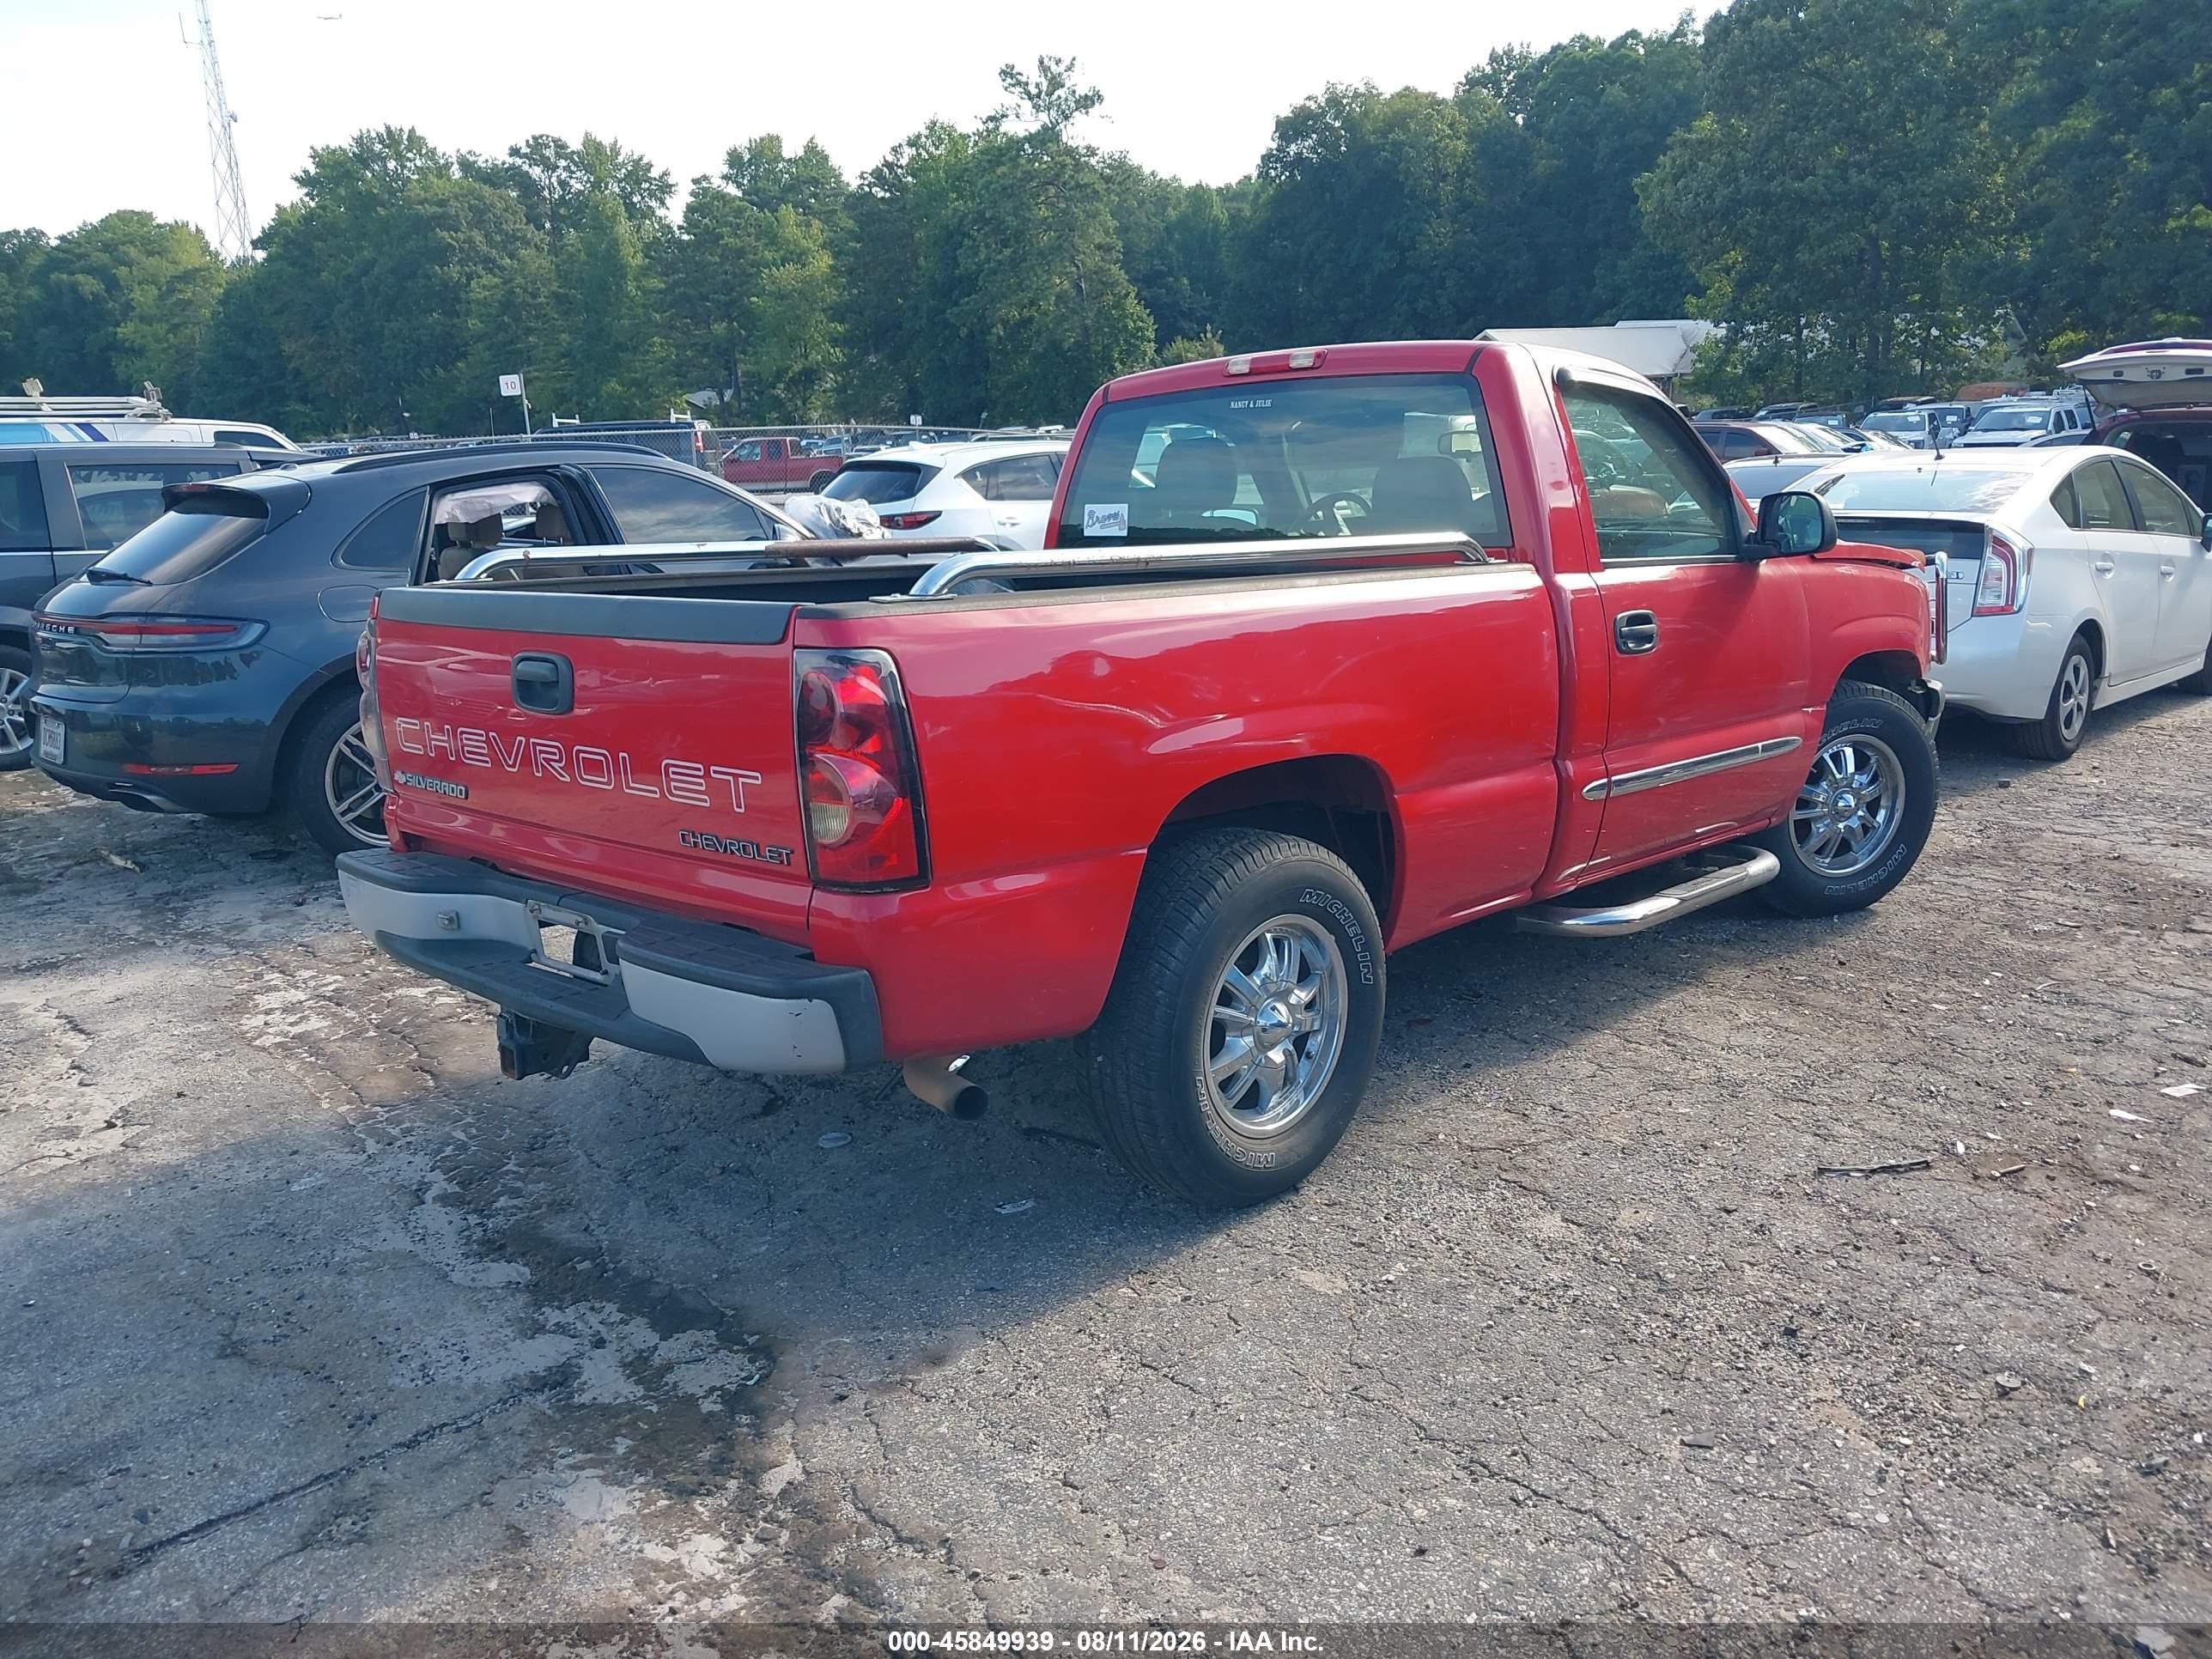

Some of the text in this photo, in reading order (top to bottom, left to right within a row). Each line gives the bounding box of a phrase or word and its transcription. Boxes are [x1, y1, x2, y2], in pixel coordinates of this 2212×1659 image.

[505, 380, 517, 390] 10
[1230, 400, 1249, 409] NANCY
[397, 717, 762, 812] CHEVROLET
[406, 773, 466, 799] SILVERADO
[678, 830, 792, 866] CHEVROLET
[1823, 843, 1908, 896] MICHELIN
[1299, 889, 1373, 984] MICHELIN
[1194, 1076, 1276, 1168] MICHELIN
